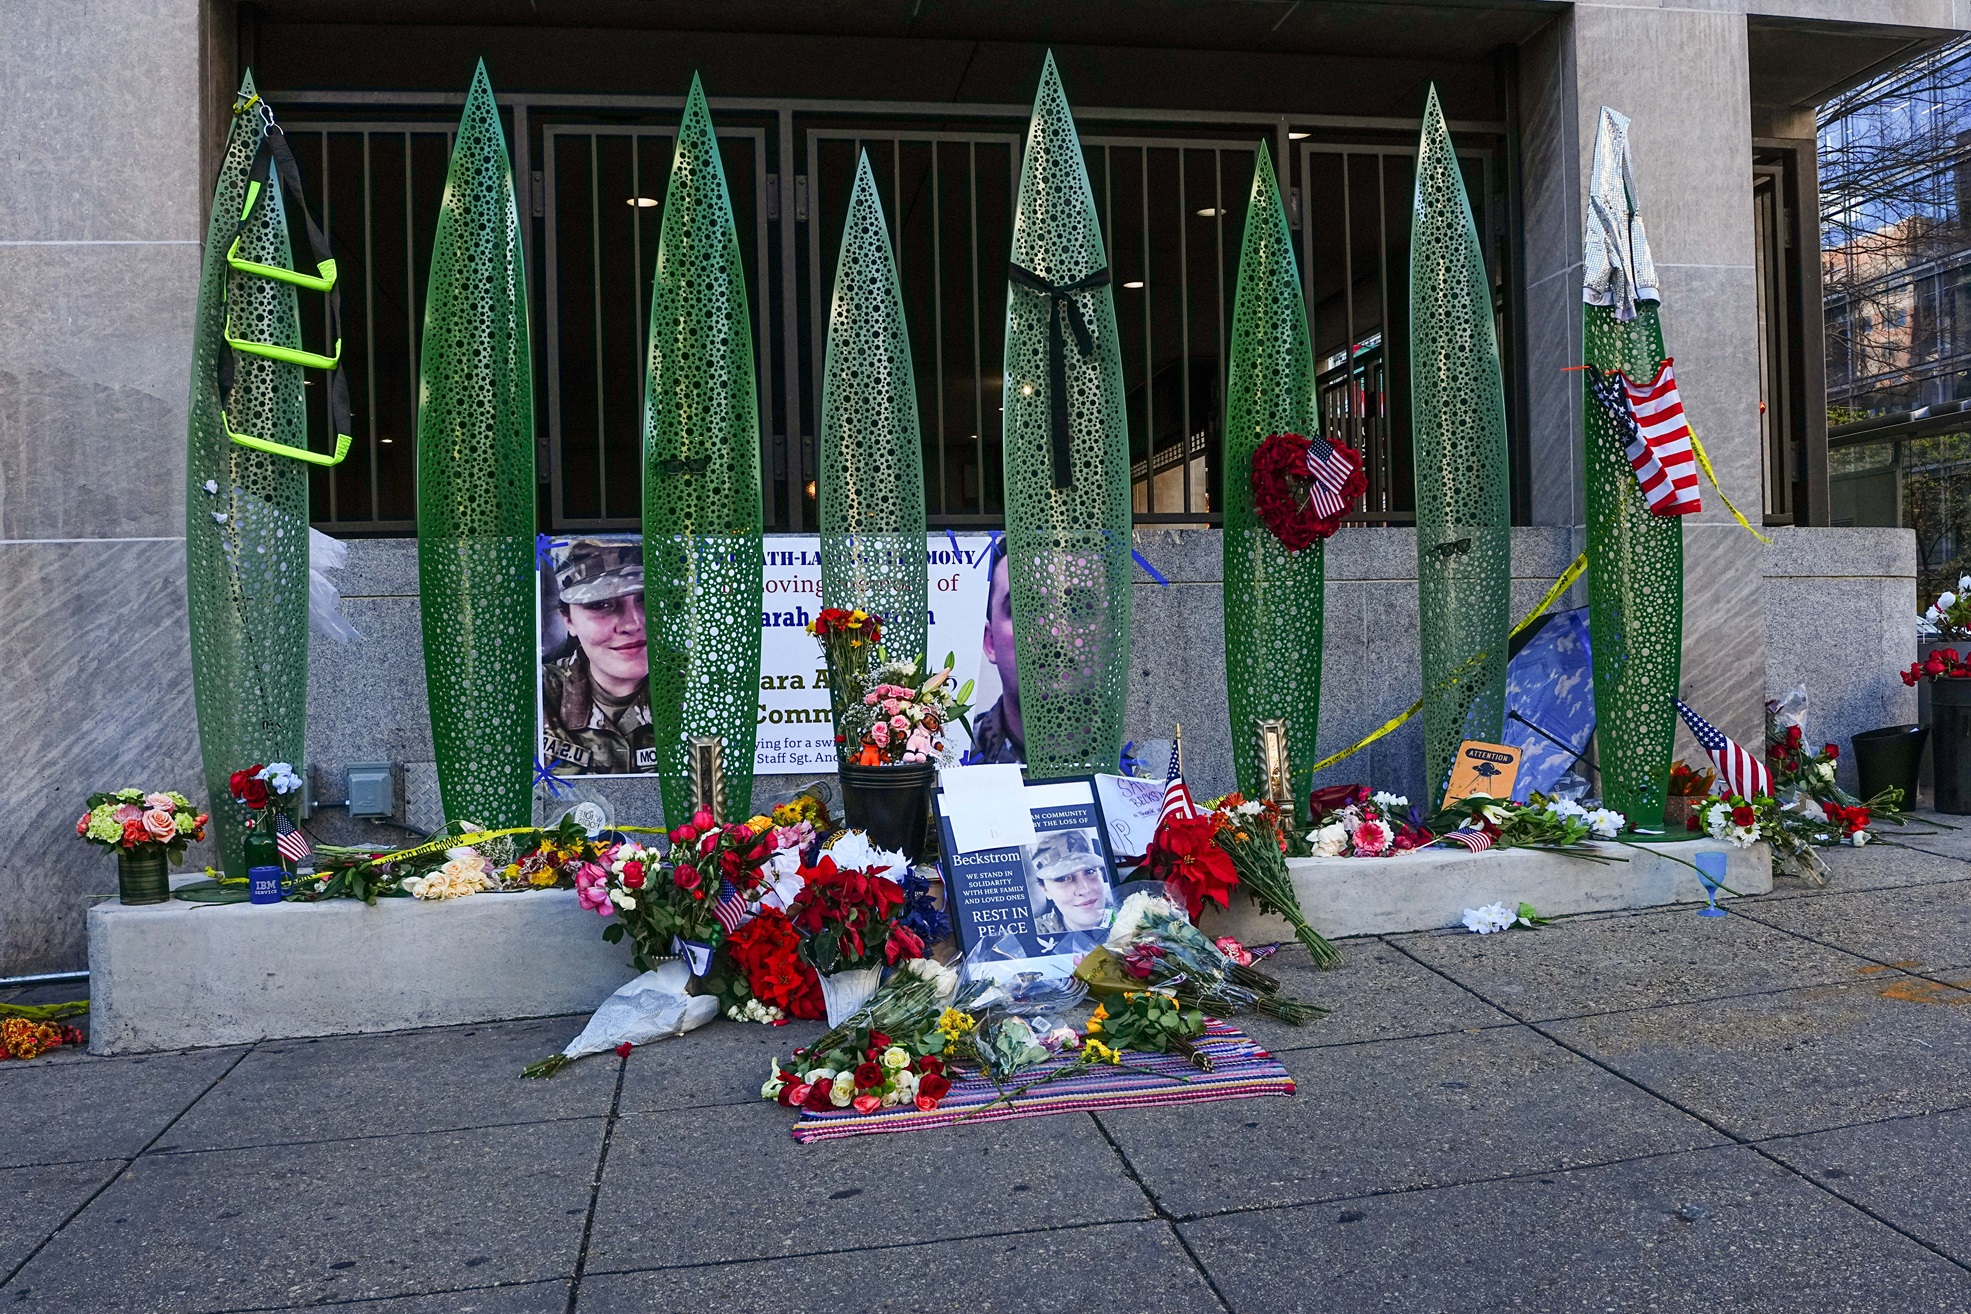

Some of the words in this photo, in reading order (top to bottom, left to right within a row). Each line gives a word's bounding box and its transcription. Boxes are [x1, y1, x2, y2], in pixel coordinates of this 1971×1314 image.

[763, 575, 823, 598] oving
[937, 573, 960, 592] of
[761, 605, 809, 627] arah
[760, 675, 806, 690] ara
[757, 704, 833, 724] Comm
[755, 737, 782, 751] ying
[784, 737, 802, 749] for
[805, 739, 812, 748] a
[815, 736, 836, 748] swi
[757, 752, 786, 764] Staff
[789, 752, 812, 766] Sgt.
[1468, 749, 1508, 762] ATTENTION
[1041, 810, 1087, 819] COMMUNITY
[952, 852, 1021, 867] Beckstrom
[980, 871, 1003, 879] STAND
[256, 880, 277, 890] IBM
[969, 879, 1012, 888] SOLIDARITY
[1000, 885, 1024, 893] FAMILY
[981, 896, 1005, 904] LOVED
[1006, 893, 1025, 901] ONES
[972, 908, 1009, 922] REST
[1012, 907, 1028, 919] IN
[978, 922, 1028, 938] PEACE
